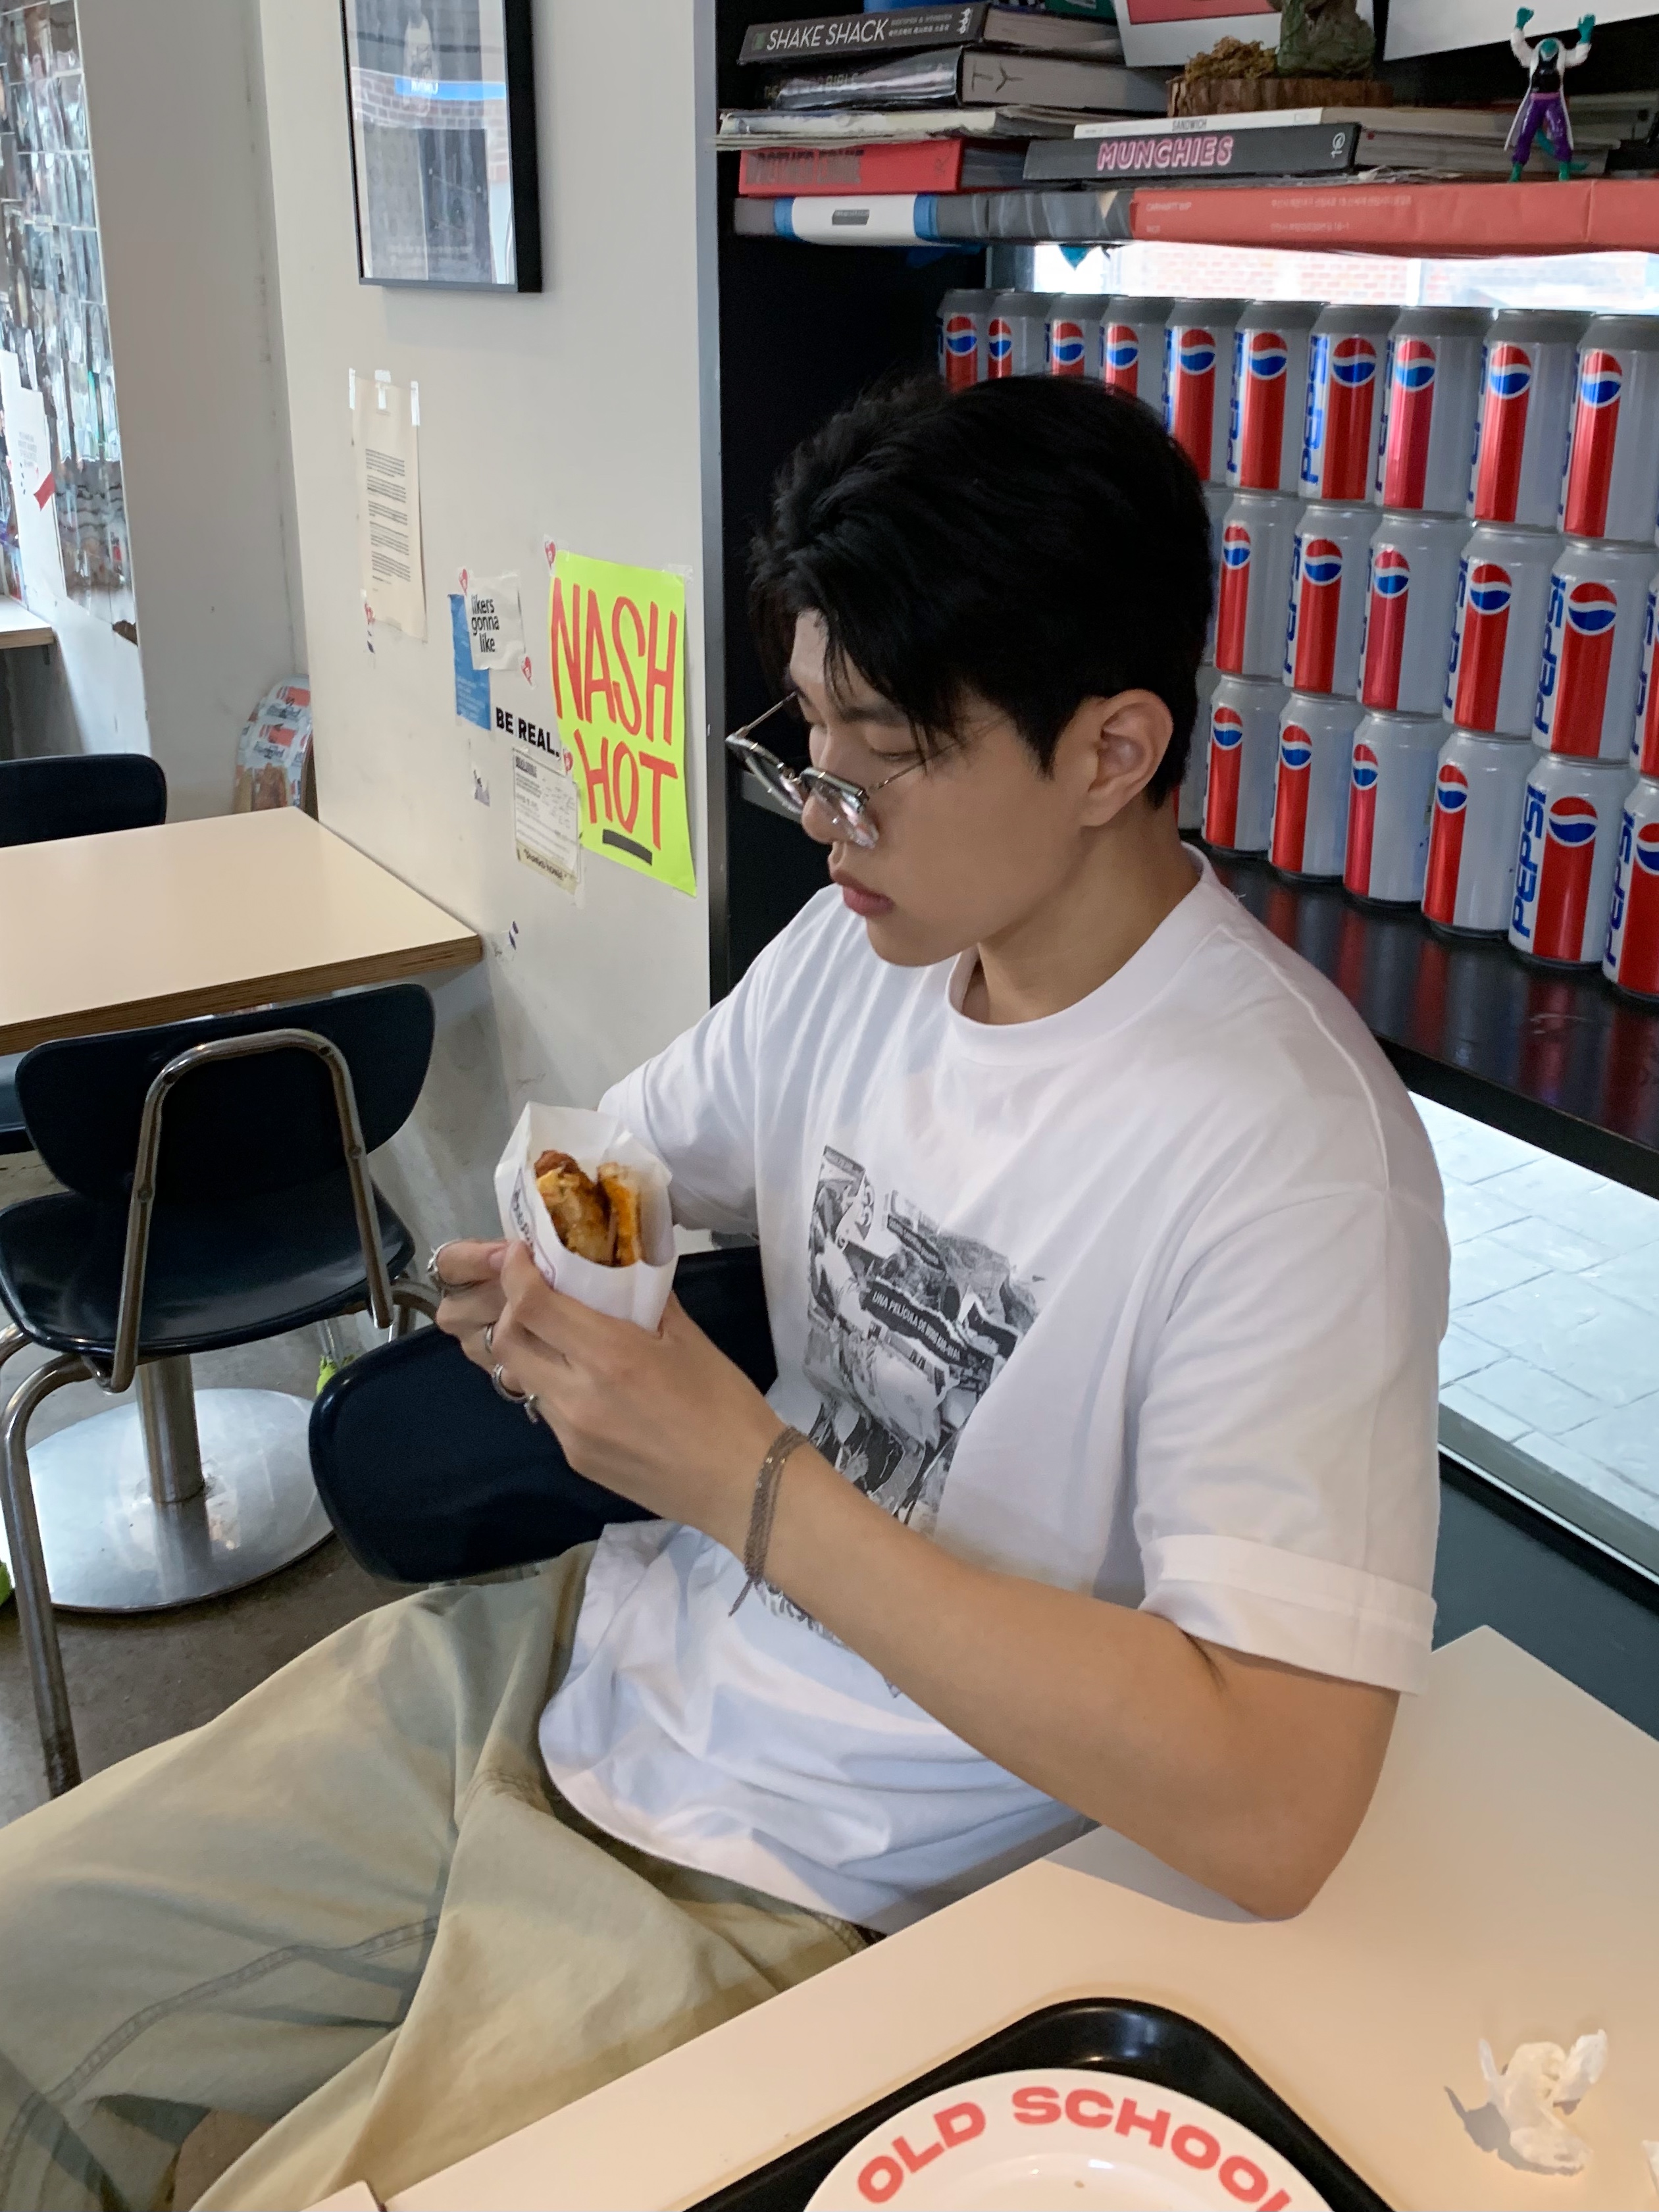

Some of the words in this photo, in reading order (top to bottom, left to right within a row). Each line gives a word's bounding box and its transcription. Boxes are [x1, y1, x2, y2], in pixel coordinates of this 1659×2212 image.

[767, 24, 825, 51] SHAKE
[825, 18, 889, 45] SHACK
[1172, 118, 1208, 132] SANDWICH
[1097, 135, 1235, 172] MUNCHIES
[471, 594, 495, 615] likers
[471, 615, 499, 636] gonna
[479, 632, 496, 653] like
[551, 577, 677, 746] NASH
[1534, 574, 1566, 734] PEPSI
[496, 707, 513, 734] BE
[518, 717, 559, 758] REAL.
[574, 729, 678, 851] HOT
[1512, 784, 1546, 939] PEPSI
[1604, 810, 1635, 967] PEPSI
[872, 1291, 889, 1310] UNA
[857, 2101, 986, 2205] OLD
